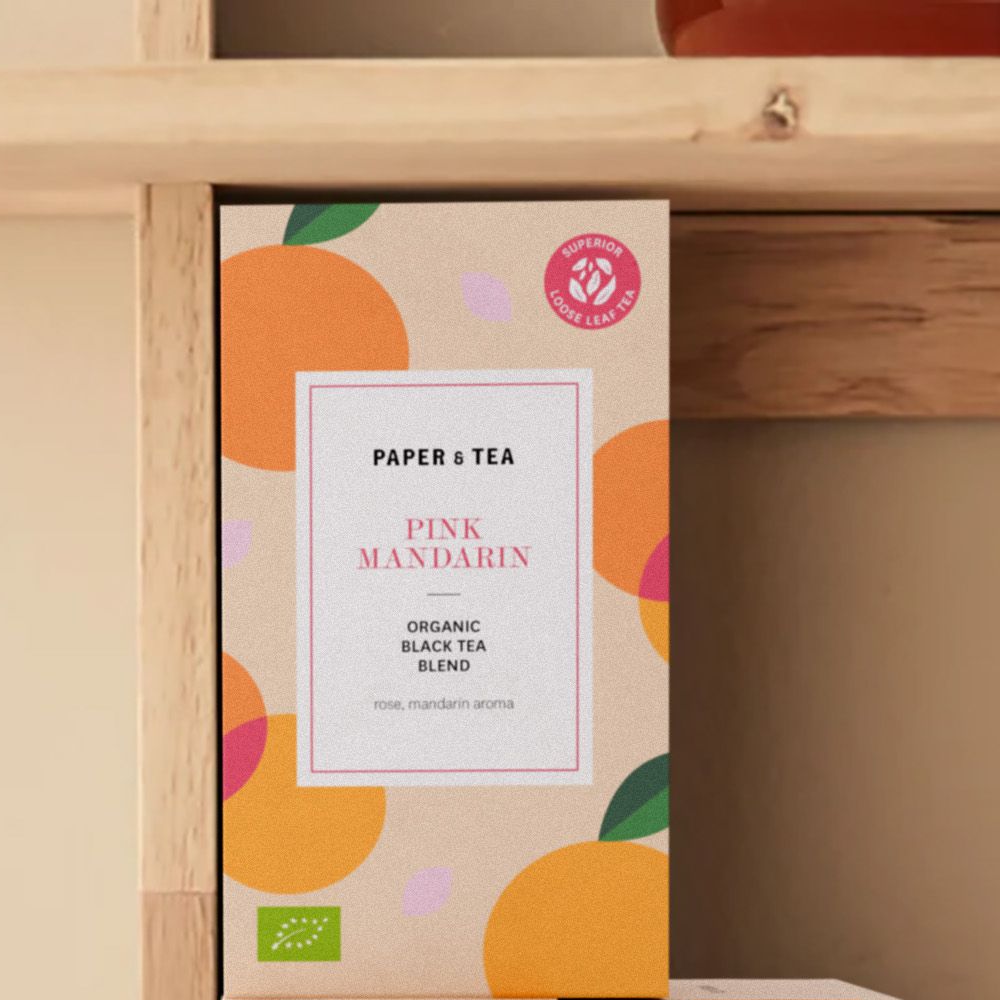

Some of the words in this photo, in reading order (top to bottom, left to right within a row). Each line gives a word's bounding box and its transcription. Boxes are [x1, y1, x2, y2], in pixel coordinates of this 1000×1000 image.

[562, 238, 623, 257] SUPERIOR
[550, 290, 582, 323] LOOSE
[586, 309, 616, 325] LEAF
[616, 290, 635, 311] TEA
[373, 449, 446, 466] PAPER
[472, 448, 515, 465] TEA
[406, 518, 483, 540] PINK
[357, 546, 532, 570] MANDARIN
[407, 620, 481, 634] ORGANIC
[401, 640, 452, 653] BLACK
[457, 640, 487, 653] TEA
[418, 660, 471, 673] BLEND
[374, 700, 405, 712] rose,
[409, 697, 471, 710] mandarin
[474, 699, 515, 710] aroma
